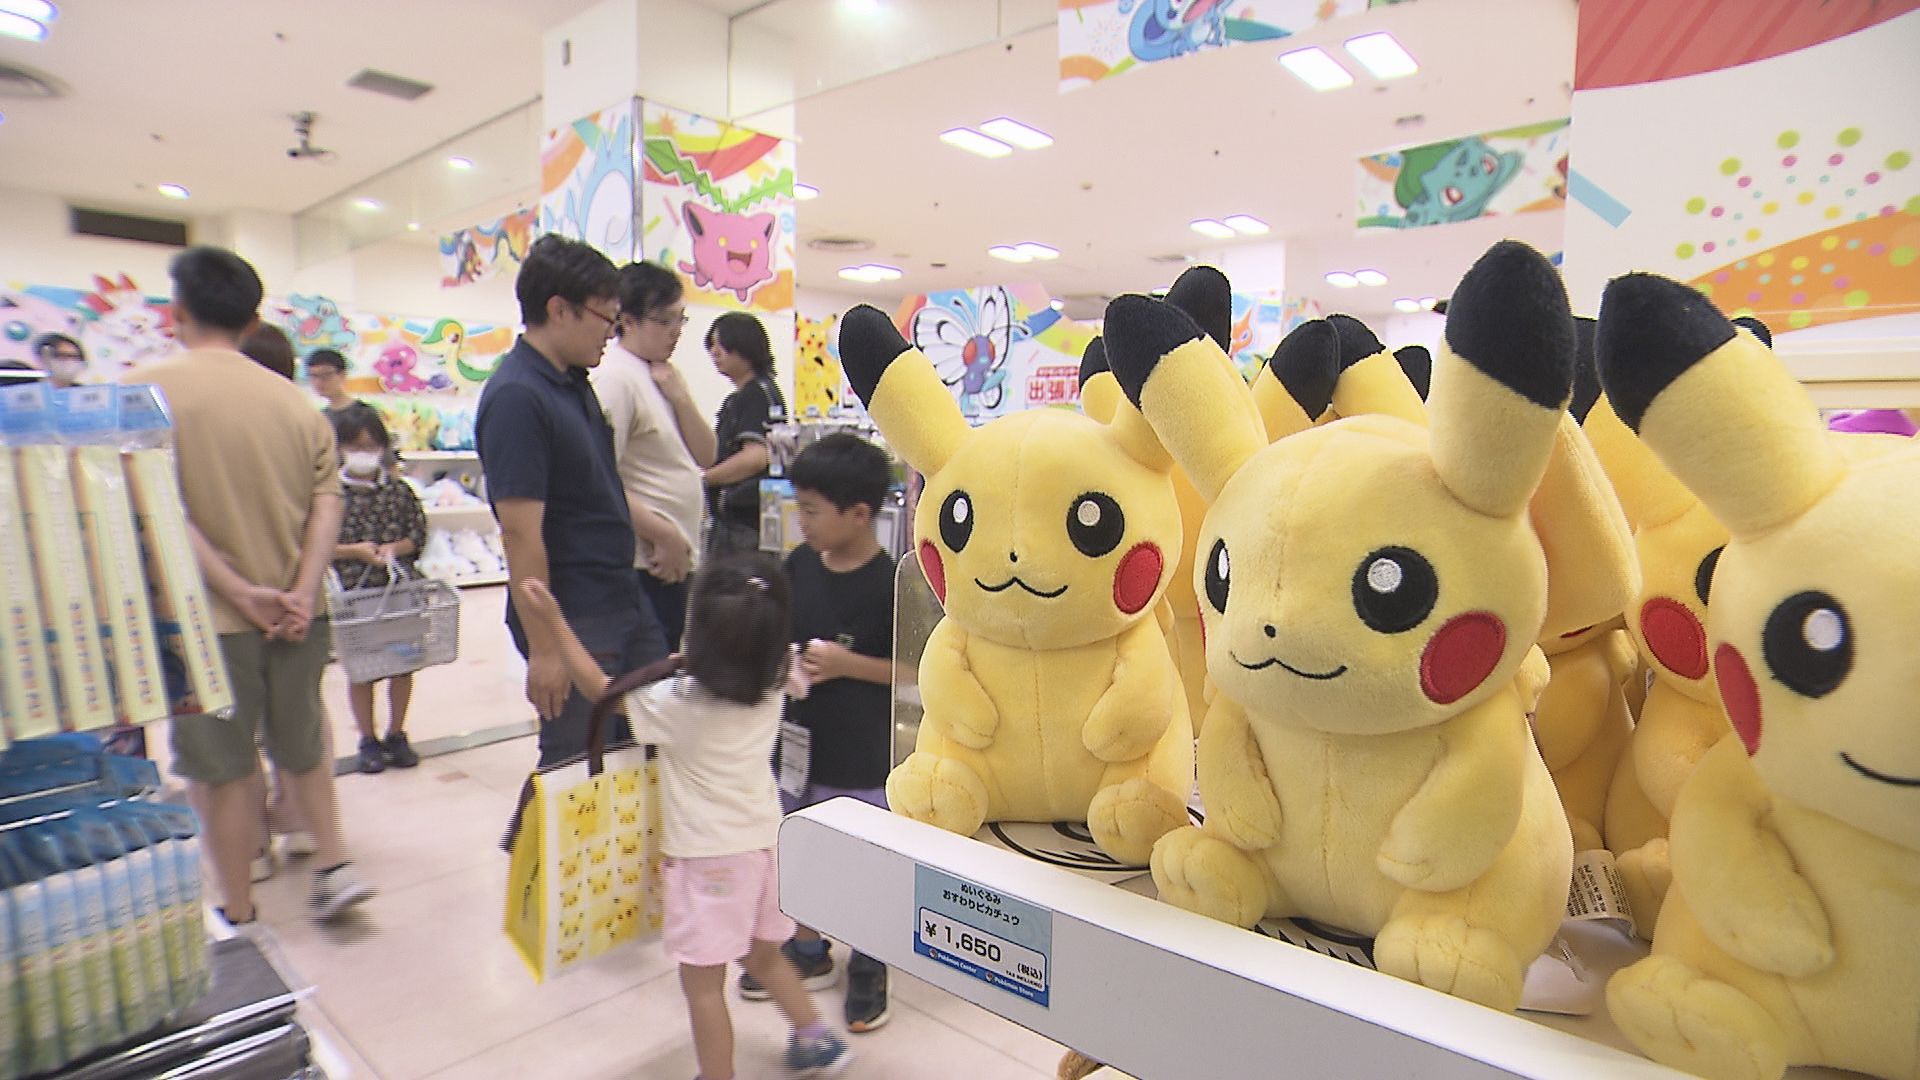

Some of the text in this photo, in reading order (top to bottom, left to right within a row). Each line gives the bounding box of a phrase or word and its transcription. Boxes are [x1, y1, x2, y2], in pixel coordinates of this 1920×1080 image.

[942, 890, 1020, 925] おすわりピカチュウ
[960, 883, 1001, 905] ぬいぐるみ
[945, 926, 1002, 962] 1,650
